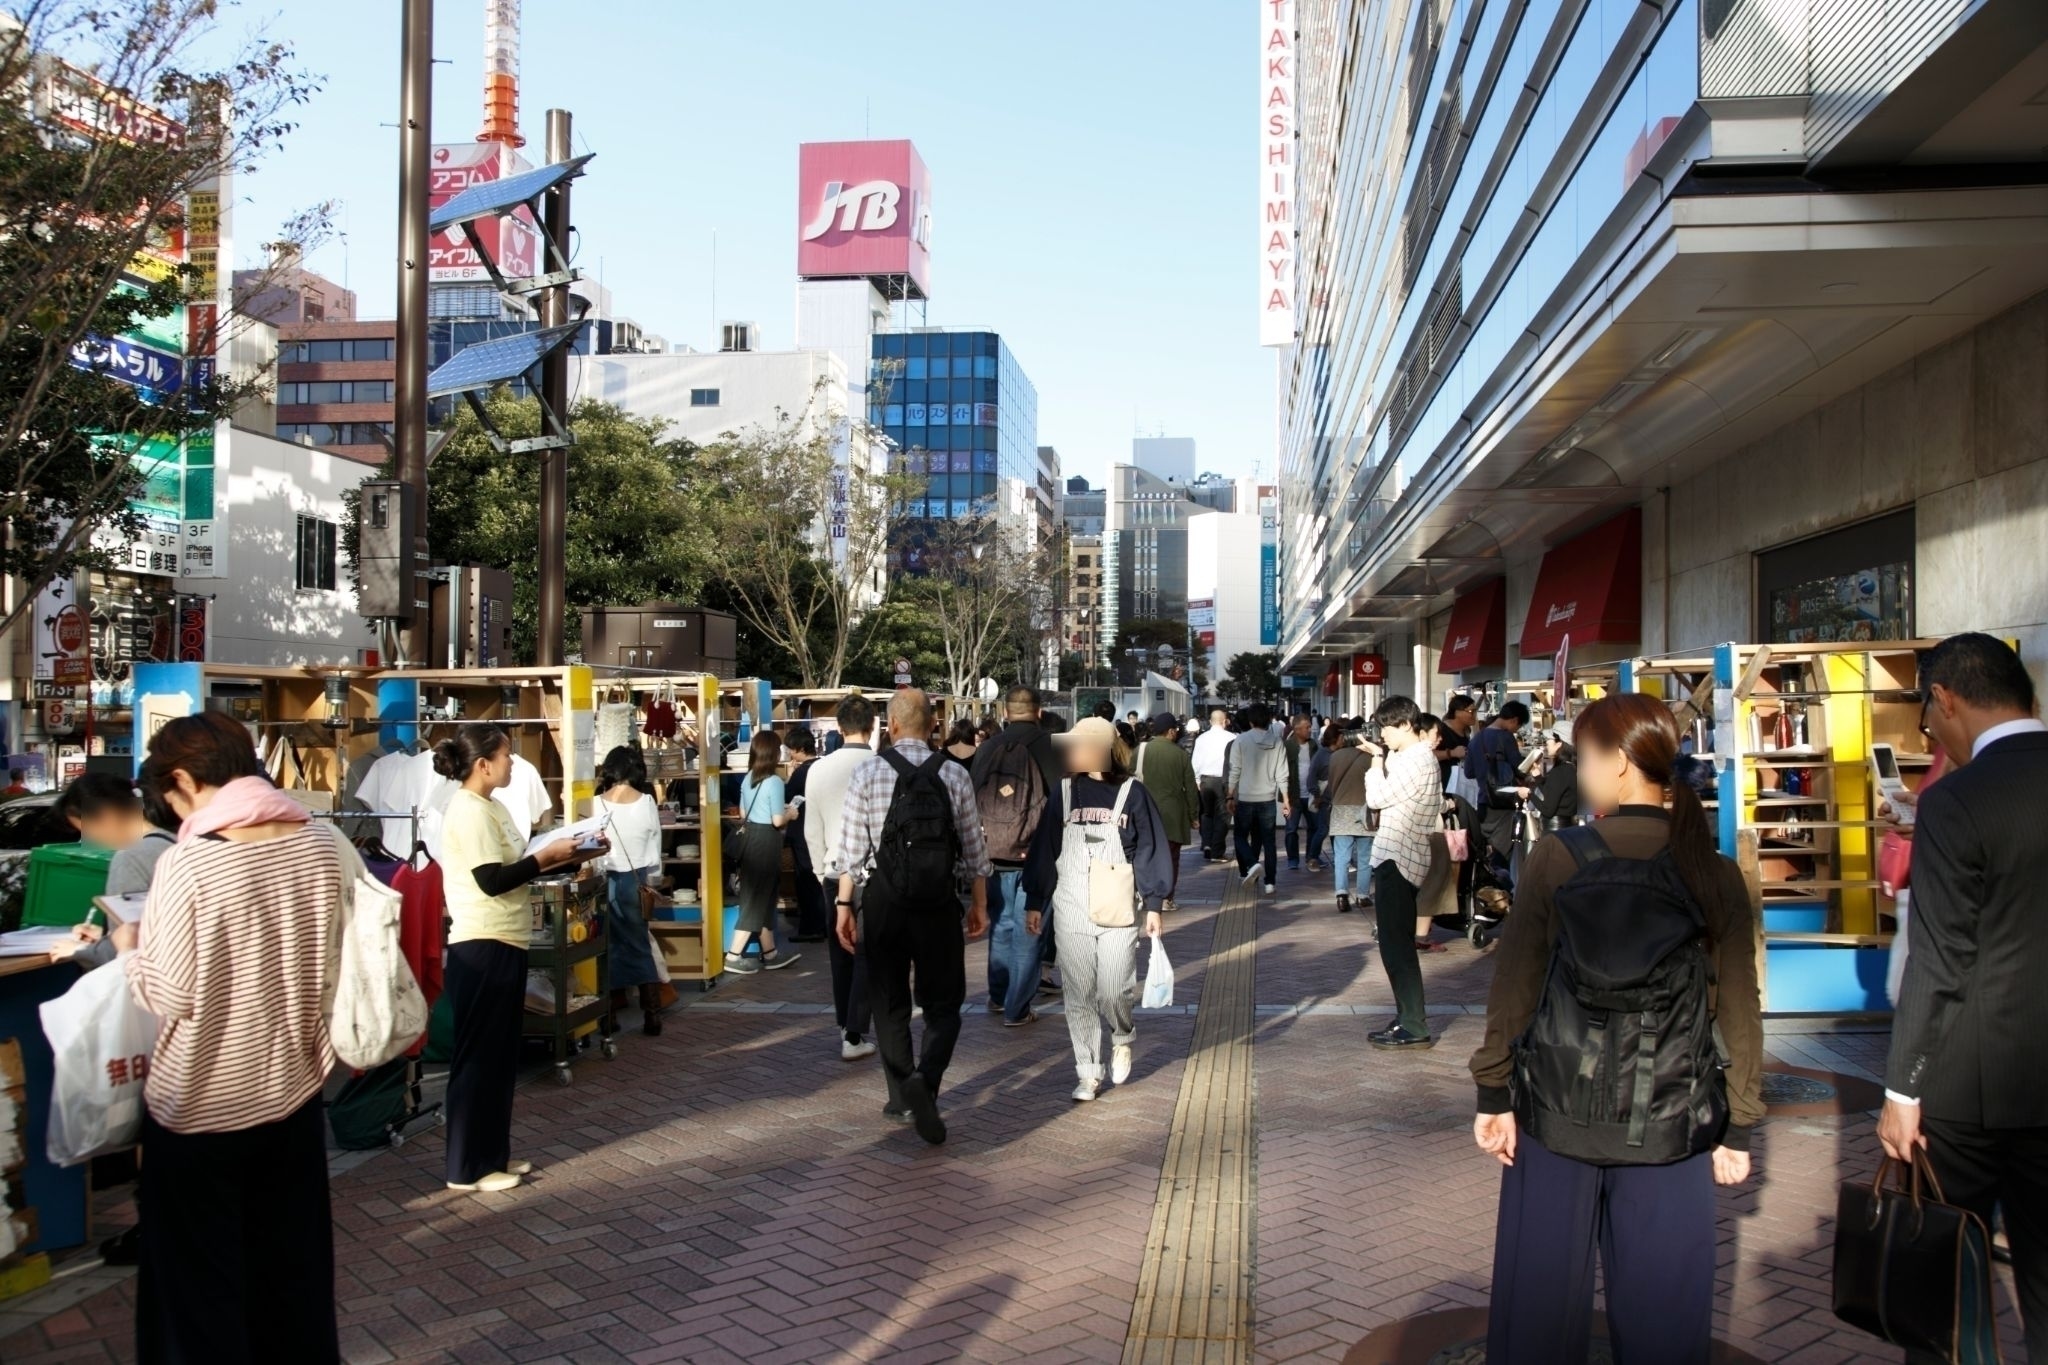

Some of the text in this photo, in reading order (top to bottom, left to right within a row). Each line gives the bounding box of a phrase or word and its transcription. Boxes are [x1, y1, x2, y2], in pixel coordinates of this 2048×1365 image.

[1267, 0, 1289, 311] TAKASHIMAYA
[433, 170, 484, 189] アコム
[803, 180, 901, 241] JTB
[429, 248, 482, 265] アイフル
[505, 251, 531, 276] アイフル
[462, 268, 477, 278] 6F
[907, 406, 969, 421] ハウスメイト
[189, 525, 209, 536] 3F
[159, 534, 176, 547] 3F
